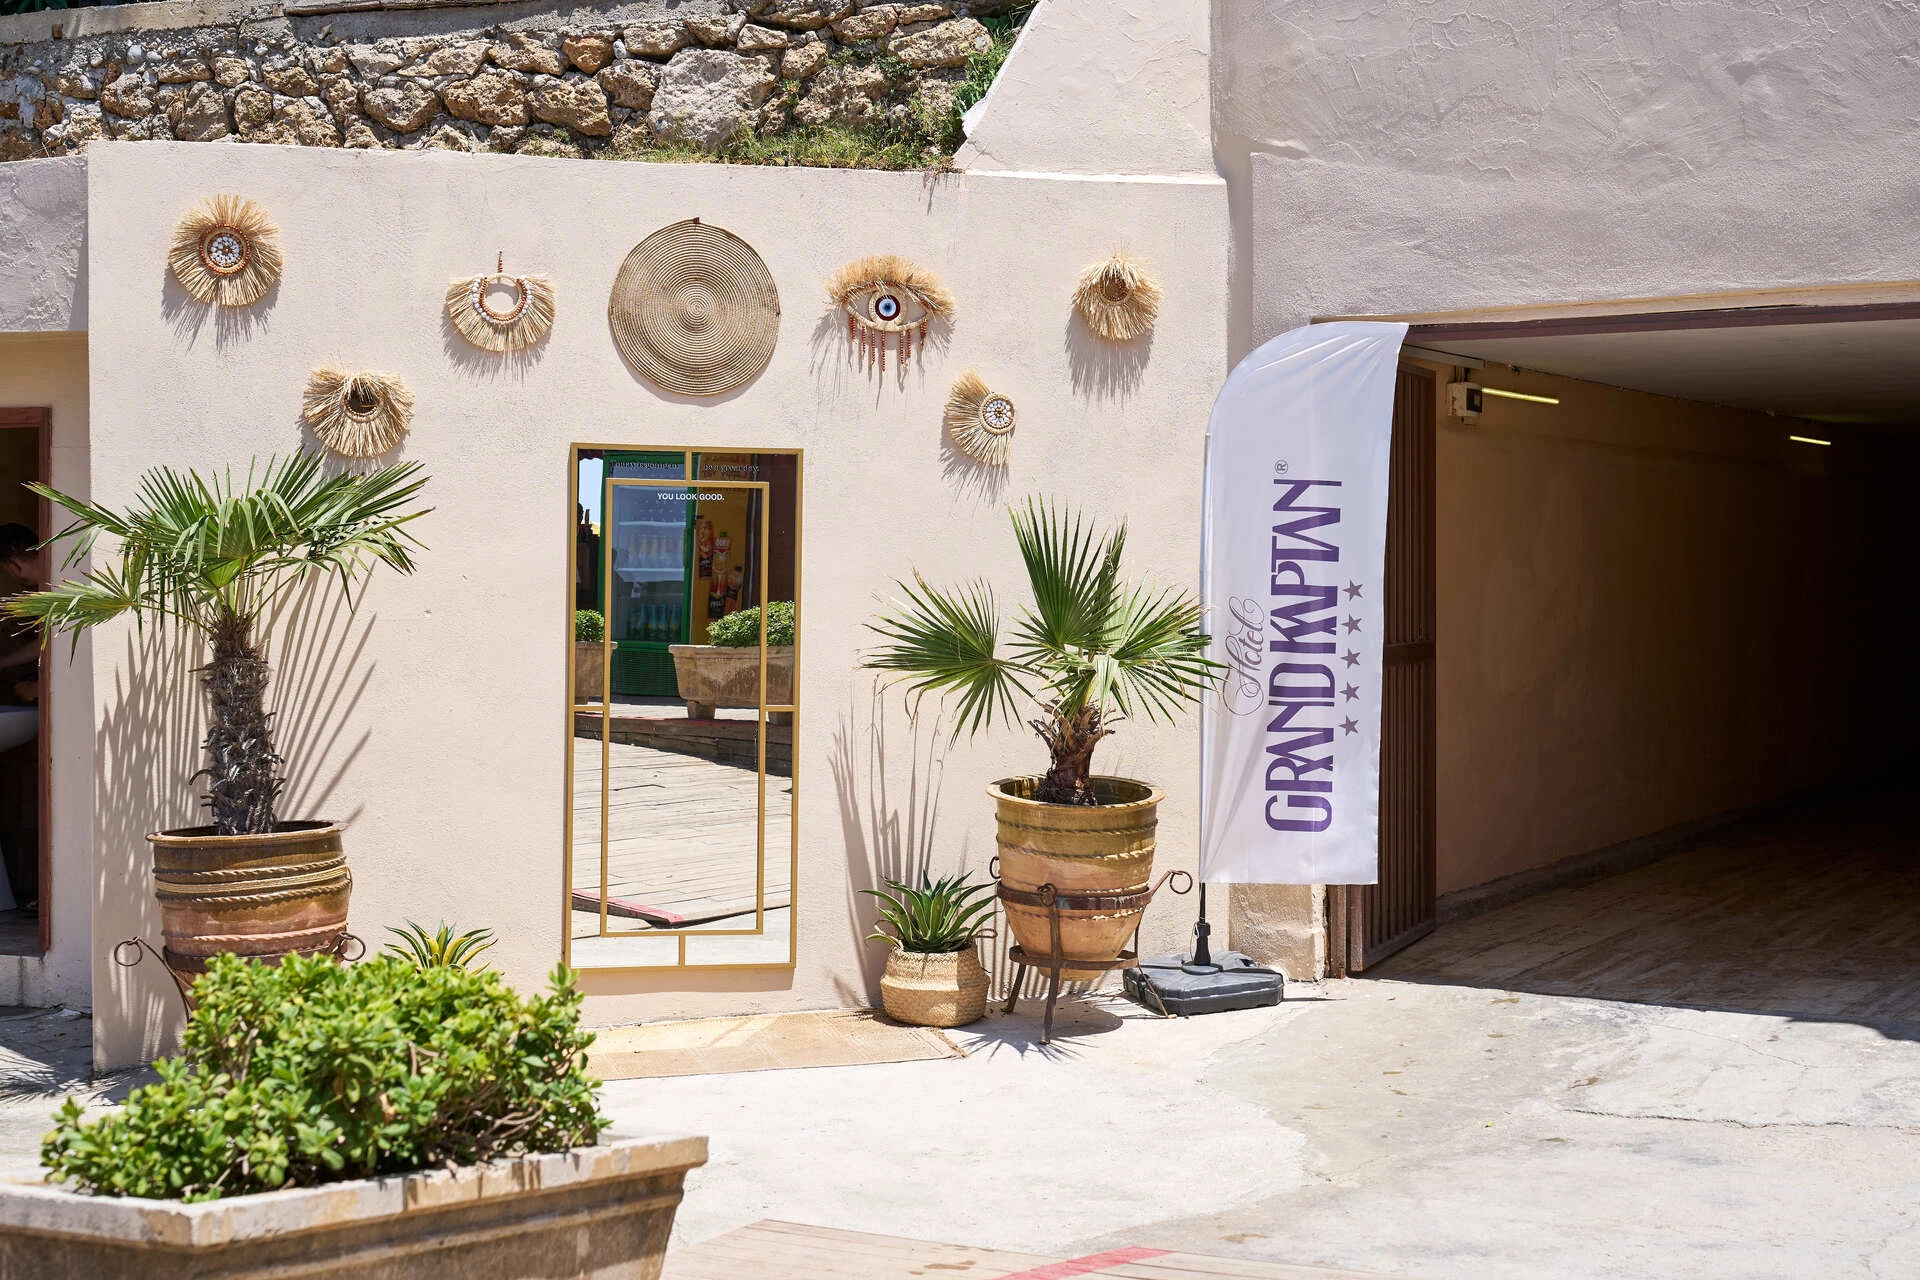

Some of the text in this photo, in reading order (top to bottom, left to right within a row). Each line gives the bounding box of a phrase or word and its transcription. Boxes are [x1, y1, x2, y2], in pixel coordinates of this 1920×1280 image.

[675, 493, 698, 501] LOOK
[699, 493, 725, 501] GOOD.
[1222, 595, 1265, 717] Hotel
[1264, 478, 1343, 833] GRAND KAPTAN
